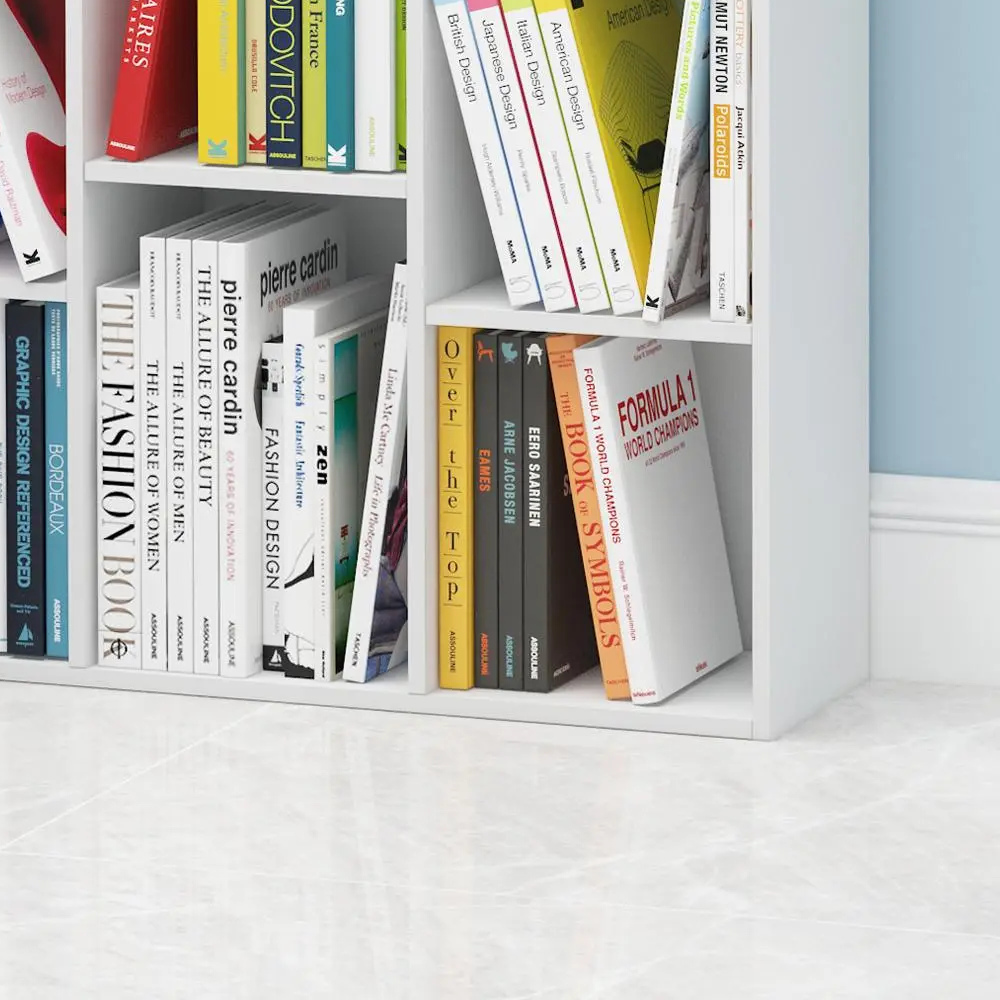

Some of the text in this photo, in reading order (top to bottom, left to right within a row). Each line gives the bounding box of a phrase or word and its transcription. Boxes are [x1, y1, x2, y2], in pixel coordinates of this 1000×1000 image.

[310, 11, 322, 69] France
[607, 4, 645, 31] American
[447, 14, 477, 103] British Design
[482, 19, 518, 130] Japanese Design
[516, 19, 546, 106] Italian Design
[550, 21, 586, 131] American Design
[675, 1, 699, 121] Pictures and Words
[715, 36, 728, 93] NEWTON
[735, 52, 744, 86] basics
[716, 106, 729, 178] Polaroids
[735, 106, 746, 170] Jacqui Atkin
[260, 238, 338, 308] pierre cardin
[507, 240, 517, 264] MoMA
[541, 245, 552, 270] MoMA
[576, 247, 587, 271] MoMA
[610, 248, 621, 273] MoMA
[717, 272, 725, 310] TASCHEN
[198, 265, 213, 507] THE ALLURE OF BEAUTY
[221, 279, 242, 435] pierre cardin
[560, 391, 572, 417] THE
[617, 369, 697, 437] FORMULA 1
[624, 431, 654, 461] WORLD
[656, 408, 700, 446] CHAMPIONS
[16, 336, 31, 589] GRAPHIC DESIGN REFERENCED
[101, 294, 137, 659] THE FASHION BOOK
[147, 360, 160, 572] THE ALLURE OF WOMEN
[173, 362, 185, 544] THE ALLURE OF MEN
[265, 427, 280, 512] FASHION
[295, 420, 305, 509] Fantastic Architecture
[317, 444, 328, 485] zen
[447, 450, 458, 509] the
[479, 449, 492, 493] EAMES
[503, 420, 517, 525] ARNE JACOBSEN
[528, 427, 541, 528] EERO SAARINEN
[565, 422, 595, 496] BOOK
[584, 368, 600, 422] FORMULA
[594, 434, 610, 475] WORLD
[602, 477, 621, 544] CHAMPIONS
[49, 444, 65, 535] BORDEAUX
[226, 450, 235, 582] 60 YEARS OF INNOVATION
[579, 500, 589, 517] OF
[265, 519, 280, 590] DESIGN
[361, 474, 384, 578] Life in Photographs
[582, 522, 620, 648] SYMBOLS
[53, 598, 61, 643] ASSOULINE
[150, 613, 158, 660] ASSOULINE
[176, 615, 184, 662] ASSOULINE
[227, 620, 236, 668] ASSOULINE
[351, 632, 362, 667] TASCHEN
[480, 632, 489, 676] ASSOULINE
[505, 634, 514, 678] ASSOULINE
[530, 636, 539, 680] ASSOULINE
